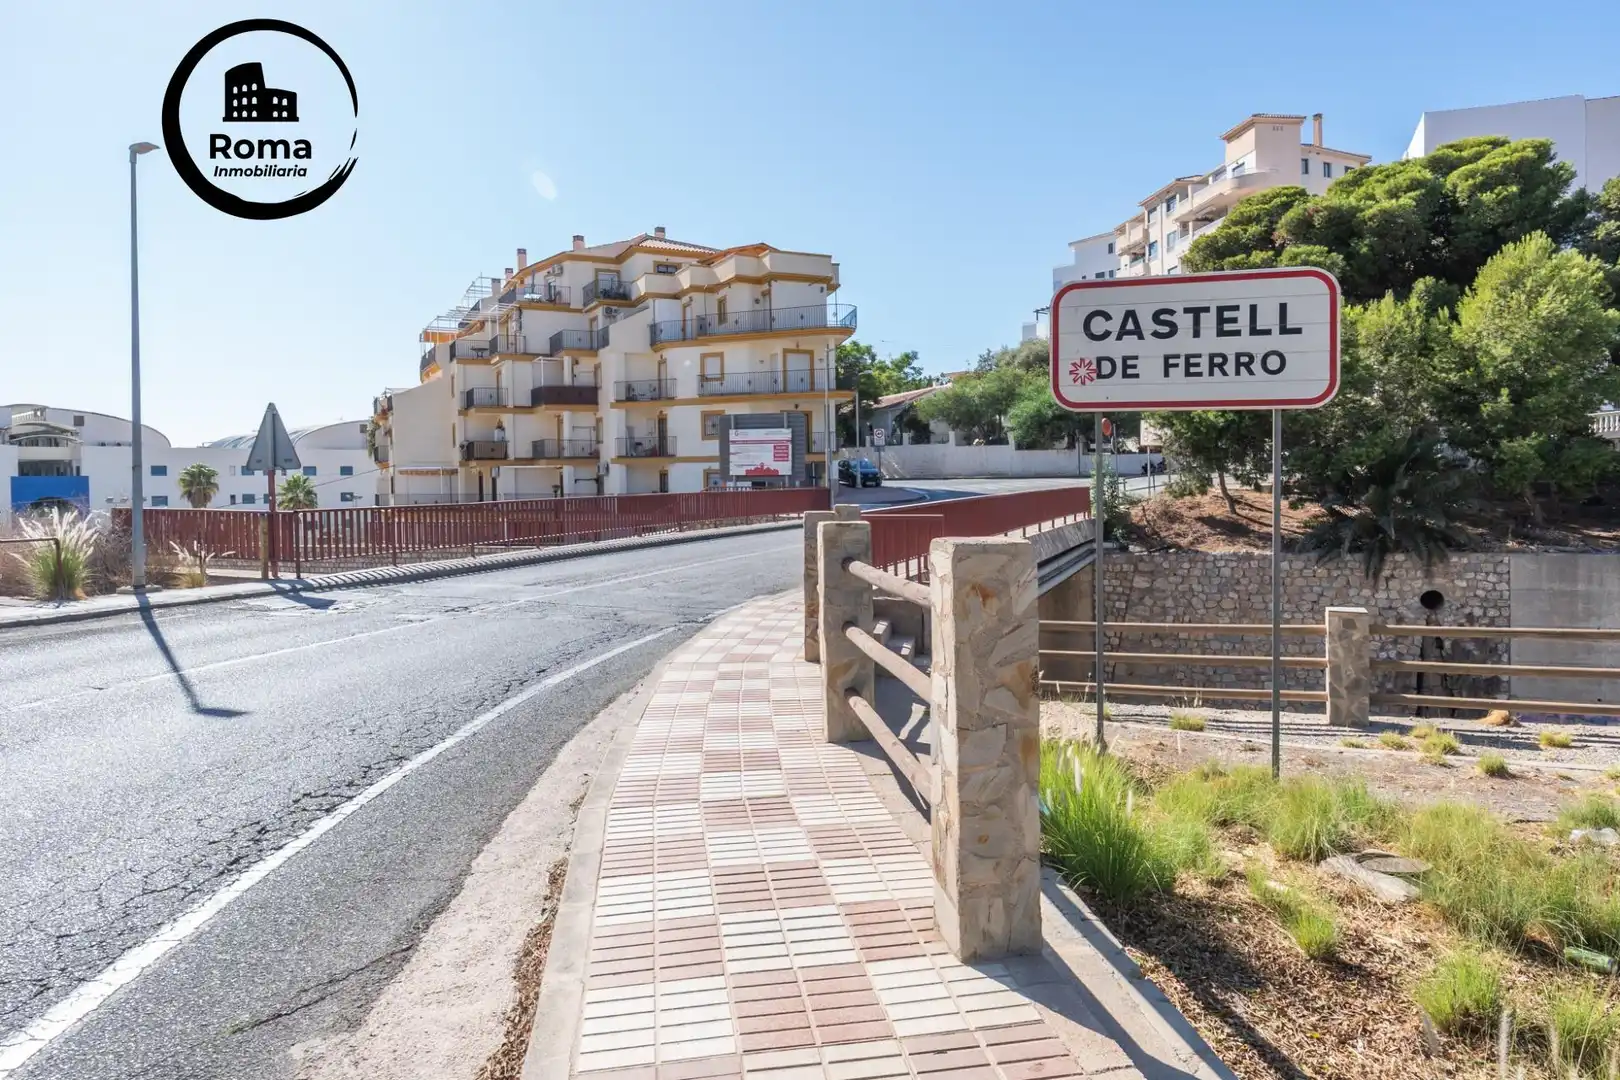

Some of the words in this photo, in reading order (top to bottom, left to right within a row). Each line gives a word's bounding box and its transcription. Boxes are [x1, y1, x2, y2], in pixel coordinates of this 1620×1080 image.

[1082, 302, 1303, 342] CASTELL
[1095, 355, 1140, 380] DE
[1163, 350, 1287, 378] FERRO
